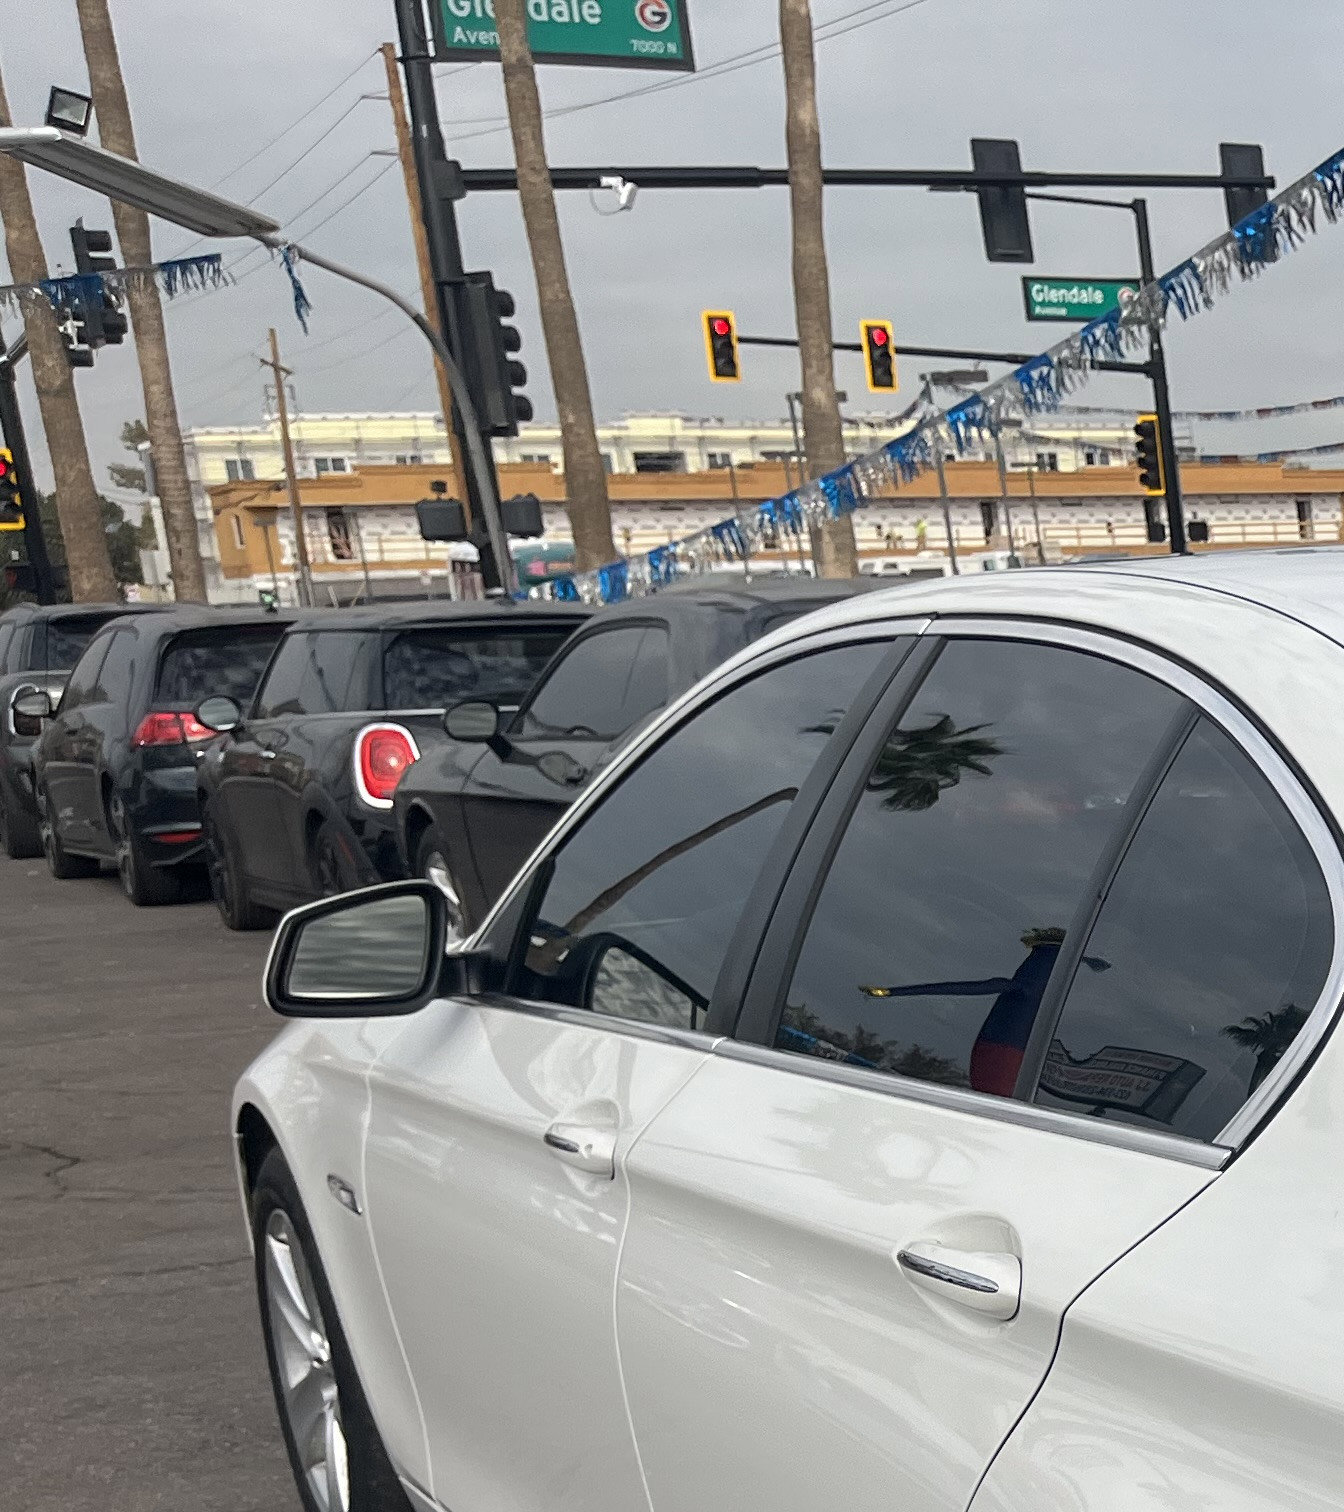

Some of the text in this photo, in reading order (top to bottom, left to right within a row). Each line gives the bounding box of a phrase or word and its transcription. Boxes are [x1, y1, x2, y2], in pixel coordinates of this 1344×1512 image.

[447, 0, 602, 25] Gldale
[453, 25, 500, 45] Aven
[1031, 284, 1104, 304] Glendale
